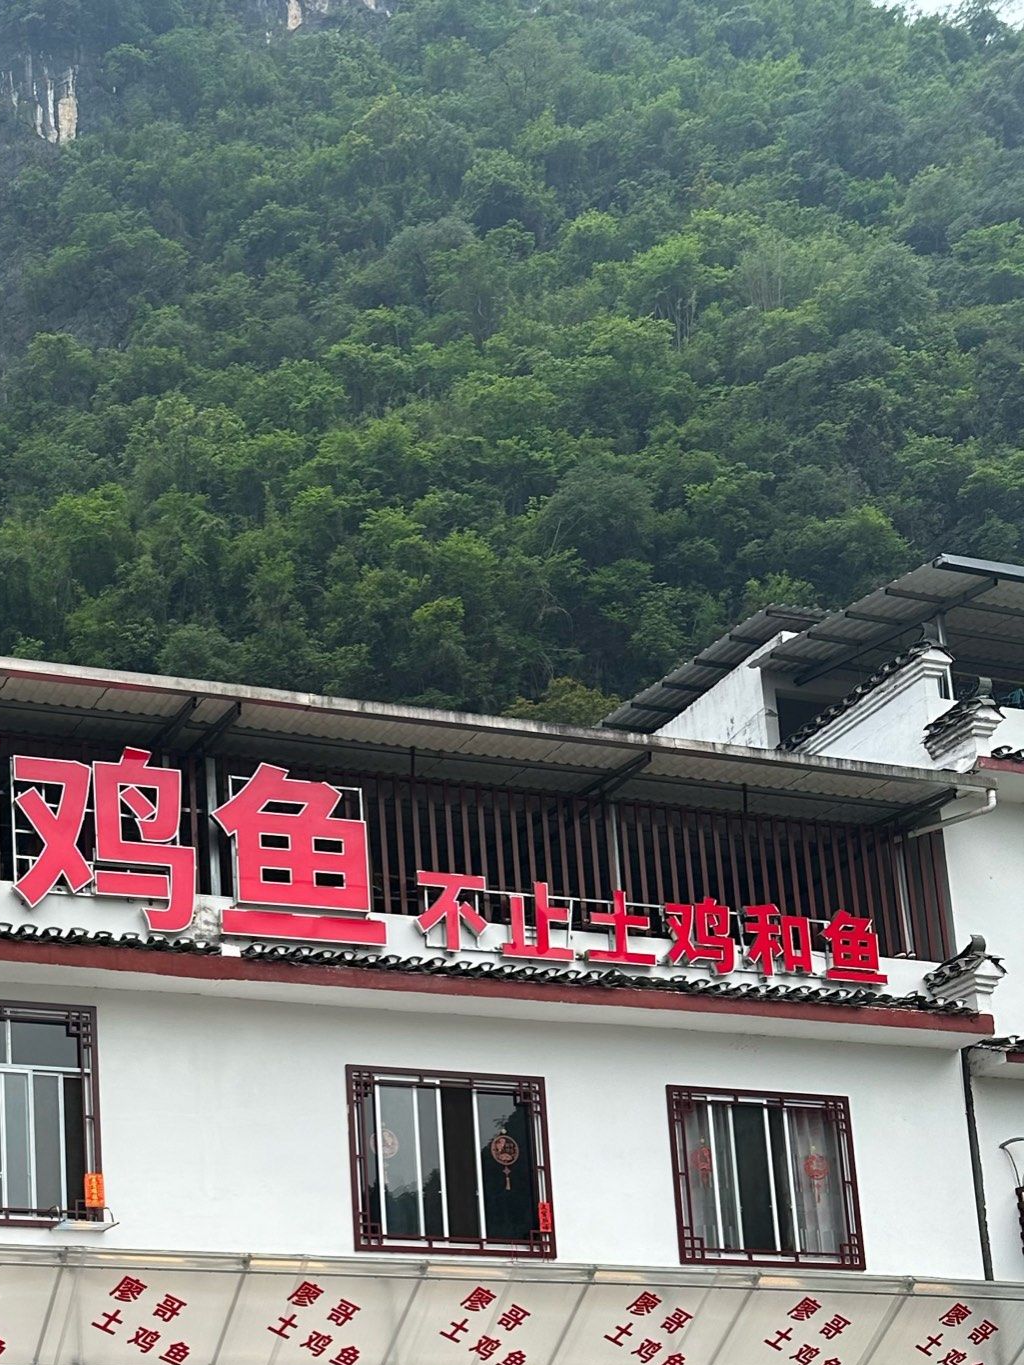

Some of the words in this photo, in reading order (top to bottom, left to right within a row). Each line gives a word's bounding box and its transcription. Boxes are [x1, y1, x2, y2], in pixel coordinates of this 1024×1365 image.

[414, 870, 888, 984] 不止土鸡和鱼
[110, 1275, 186, 1323] 廖哥
[291, 1281, 359, 1327] 廖哥
[460, 1286, 530, 1331] 廖哥
[631, 1291, 693, 1332] 廖哥
[792, 1297, 850, 1339] 廖哥
[940, 1302, 999, 1343] 廖哥
